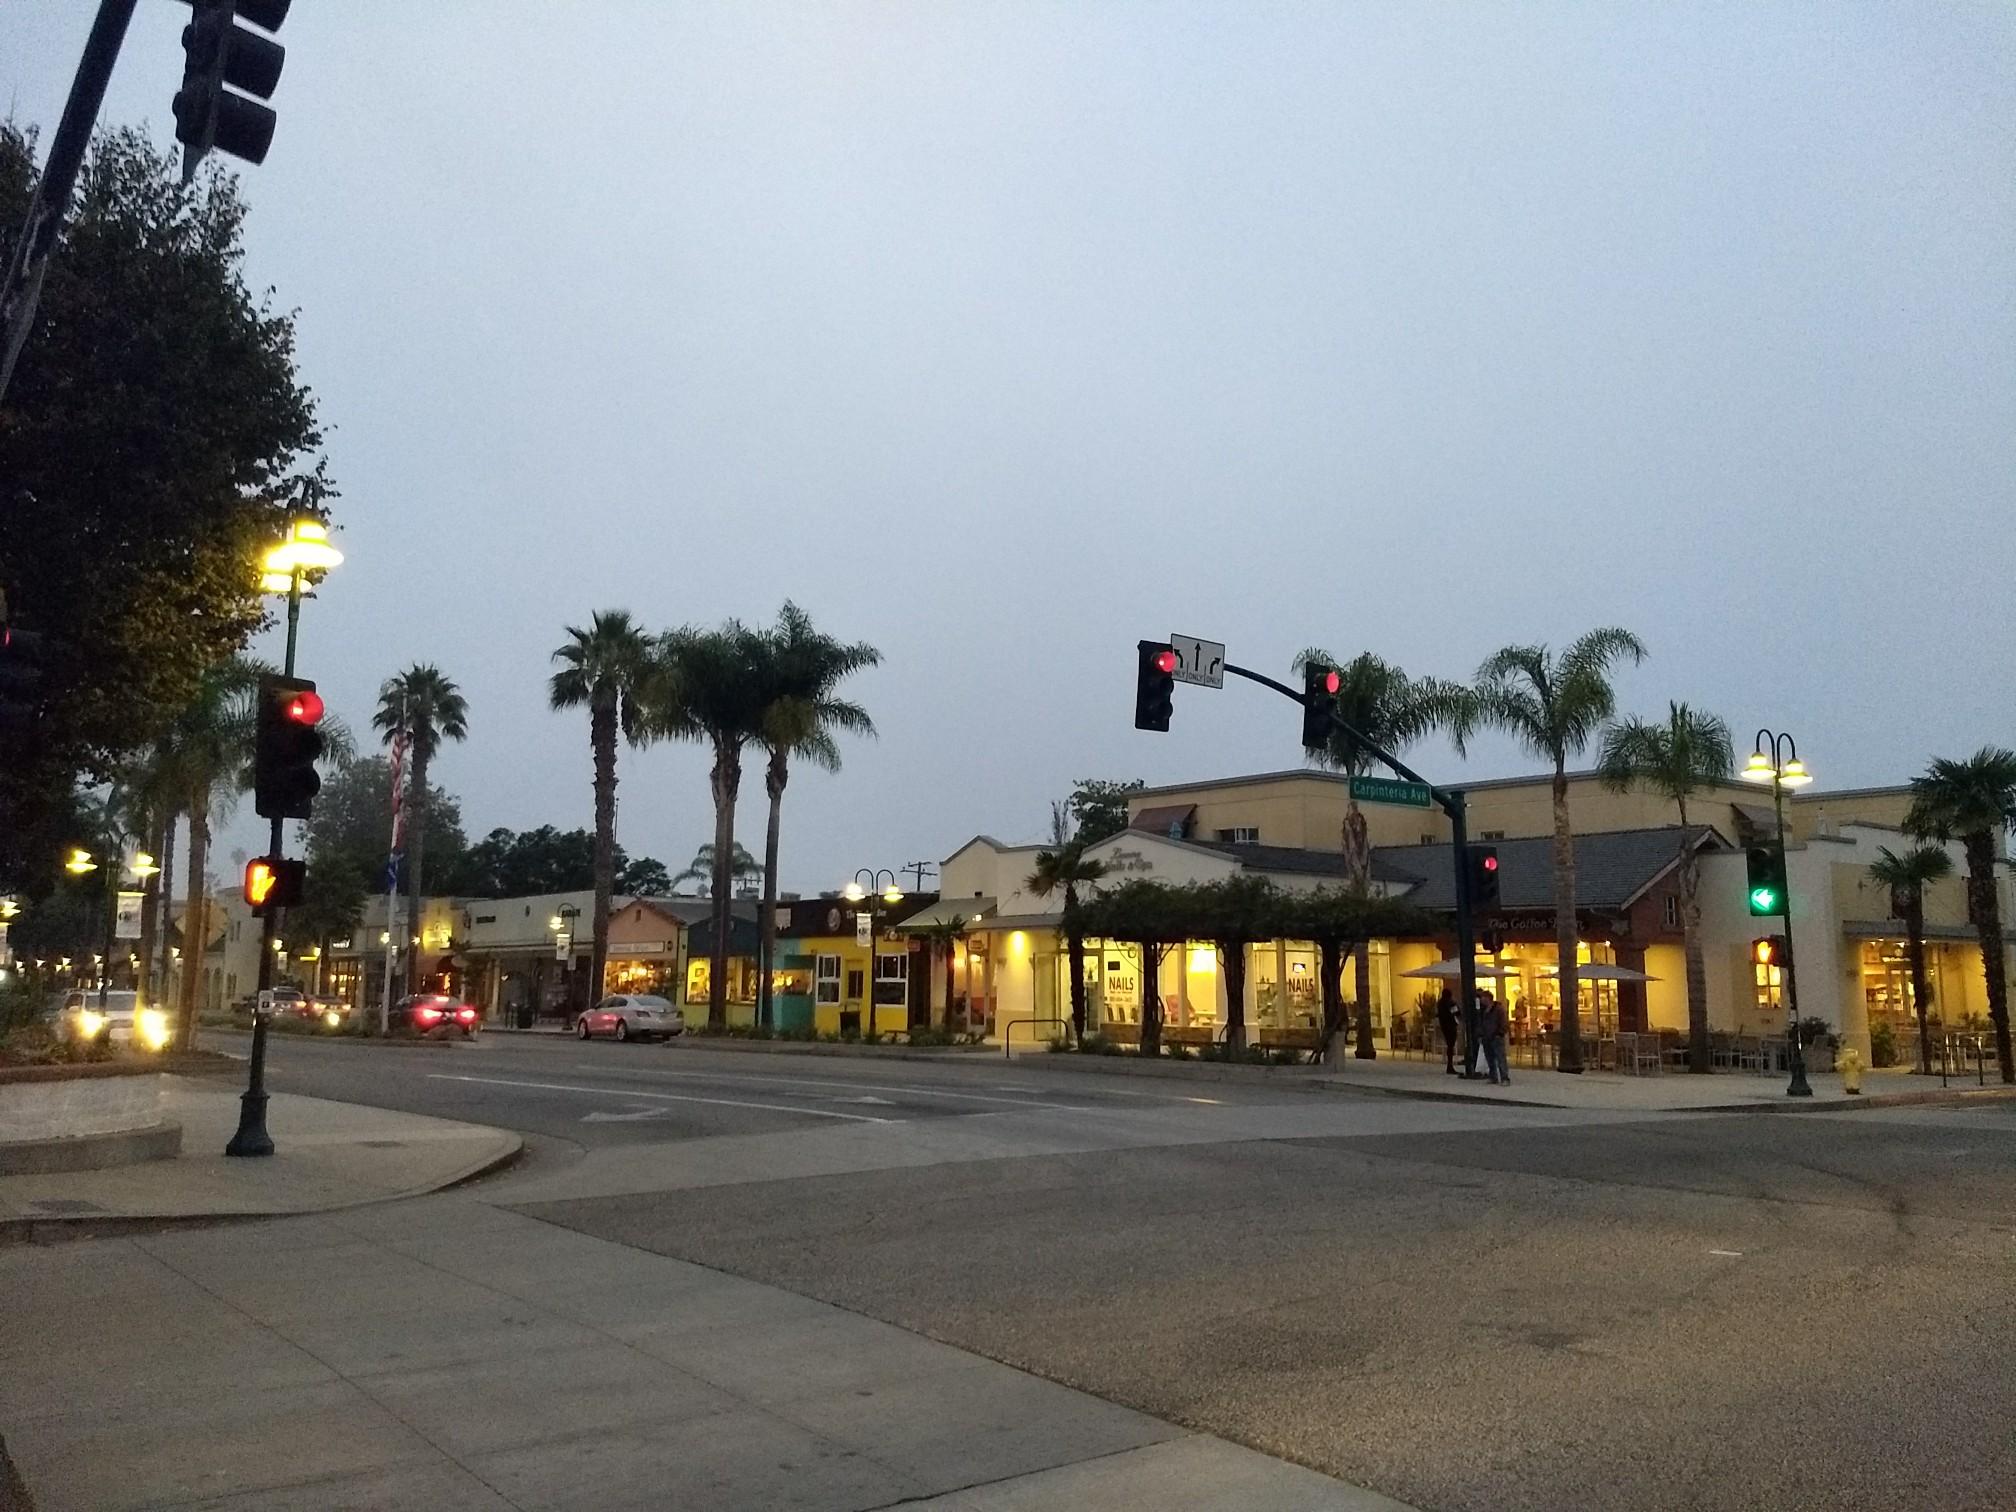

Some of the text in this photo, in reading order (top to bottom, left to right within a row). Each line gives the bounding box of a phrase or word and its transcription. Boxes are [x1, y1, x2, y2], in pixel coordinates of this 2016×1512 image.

[1189, 672, 1203, 681] ONLY
[1206, 675, 1221, 685] ONLY
[1354, 781, 1427, 801] Carpinteria Ave
[1488, 918, 1508, 929] The
[1510, 918, 1547, 929] Coffee
[1109, 976, 1133, 990] NAILS
[1288, 977, 1313, 992] NAILS
